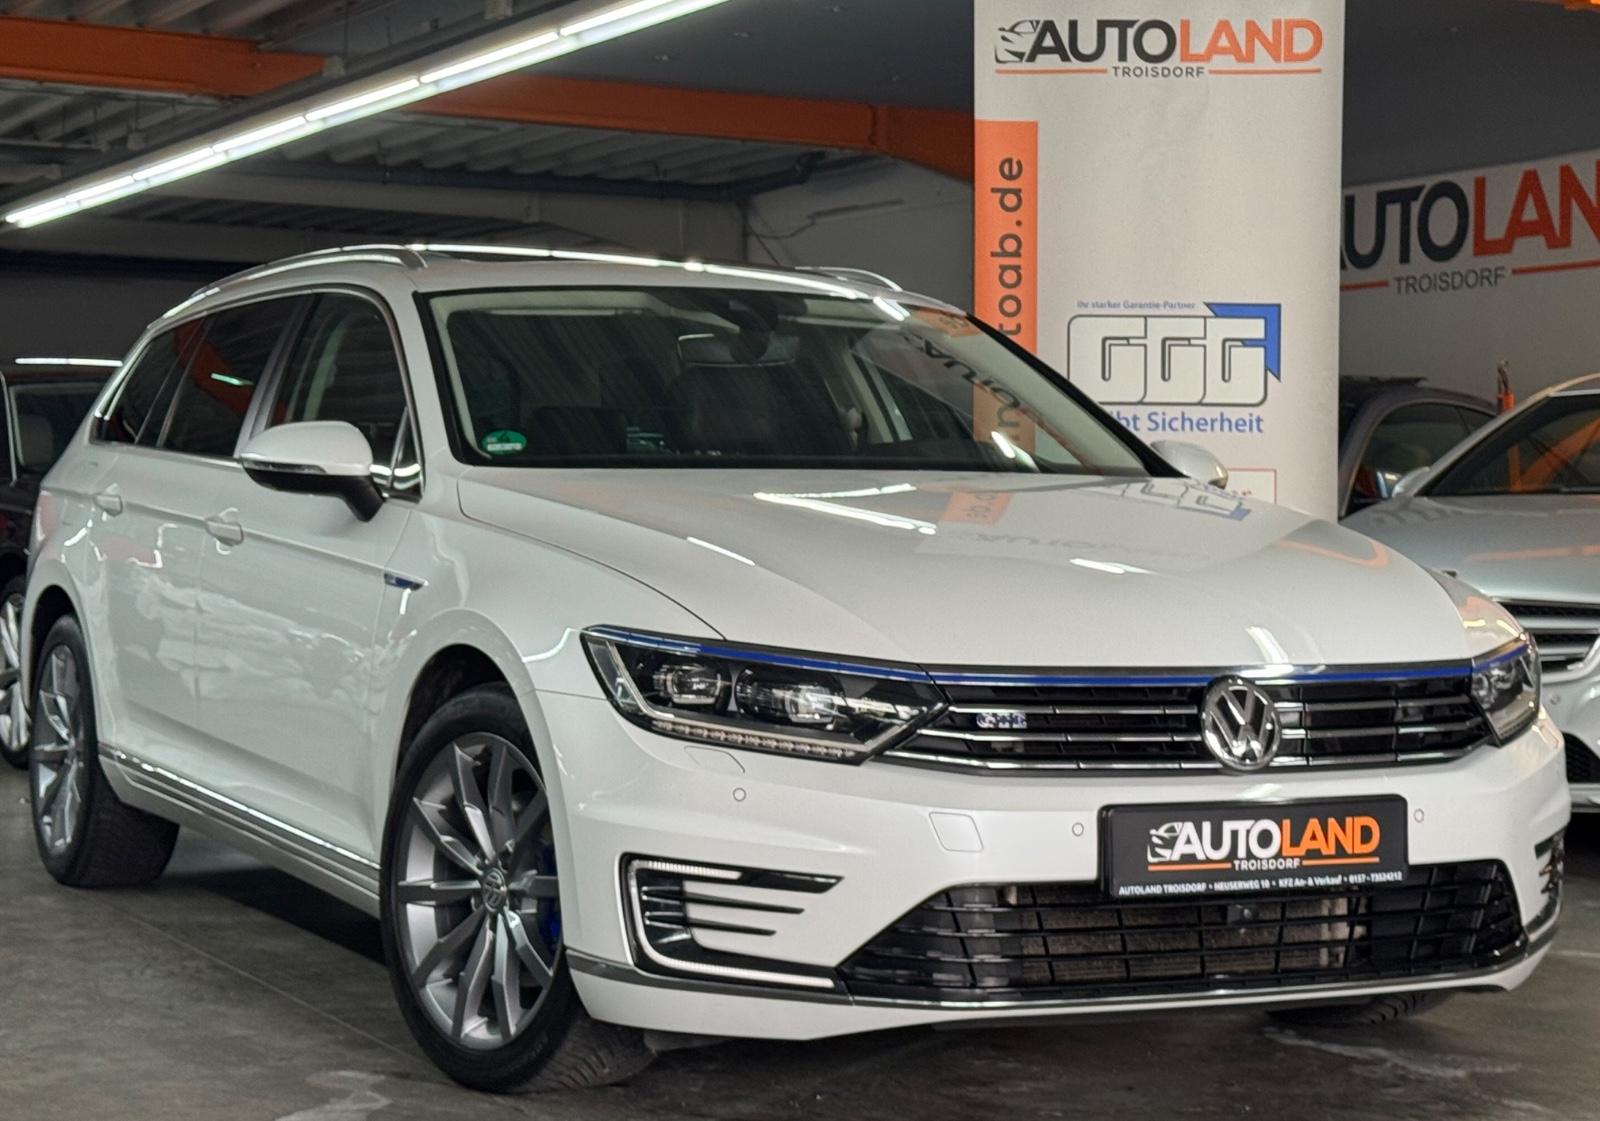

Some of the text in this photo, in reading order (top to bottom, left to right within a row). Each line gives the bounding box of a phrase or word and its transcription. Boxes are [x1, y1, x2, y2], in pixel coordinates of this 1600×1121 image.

[1025, 19, 1323, 64] AUTOLAND
[1112, 66, 1205, 78] TROISDORF
[1341, 161, 1600, 270] UTOLAN
[1393, 266, 1506, 295] TROISDORF
[1077, 300, 1089, 308] Ihr
[1091, 300, 1121, 309] starker
[1147, 411, 1264, 434] Sicherheit
[1171, 816, 1381, 861] AUTOLAND
[1233, 858, 1301, 871] TROISDORF
[1119, 885, 1162, 895] AUTOLAND
[1163, 882, 1207, 893] TROISDORF
